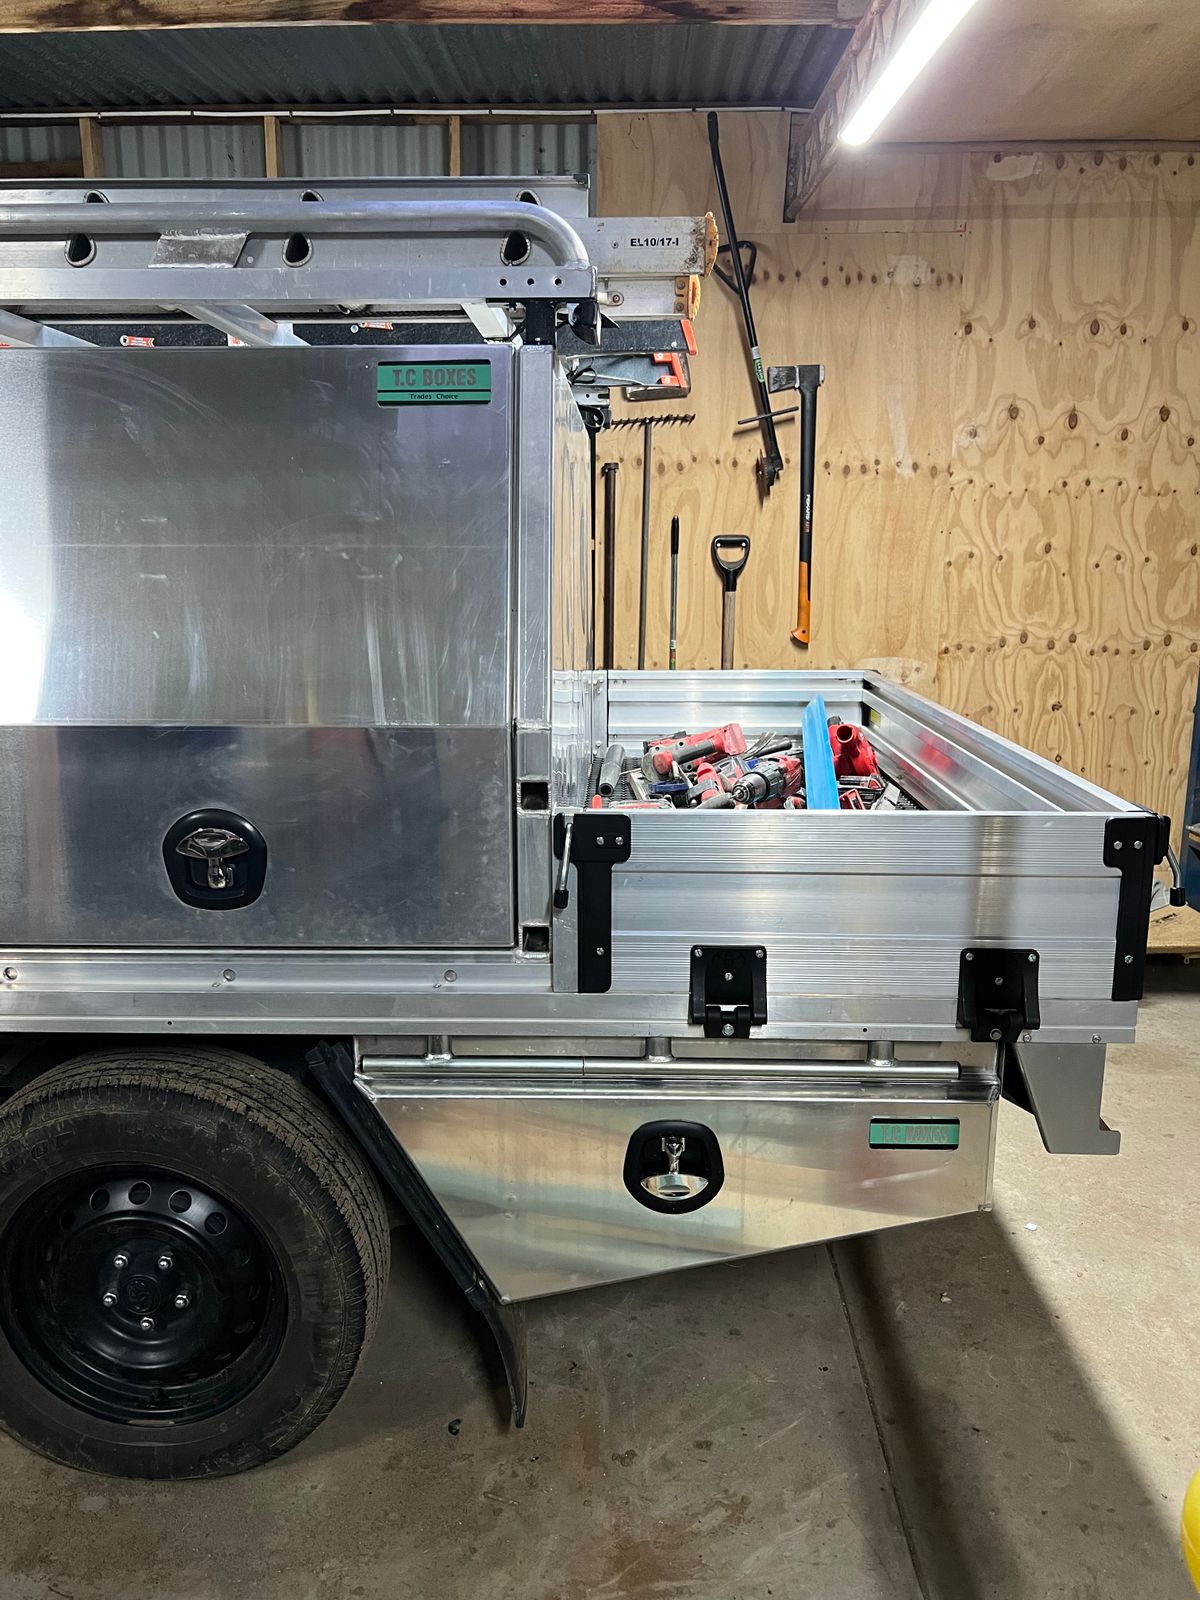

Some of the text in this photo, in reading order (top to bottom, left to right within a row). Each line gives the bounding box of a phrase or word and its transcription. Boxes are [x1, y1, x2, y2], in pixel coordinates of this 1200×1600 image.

[392, 367, 477, 387] T.C BOXES
[905, 1125, 948, 1143] BOXES
